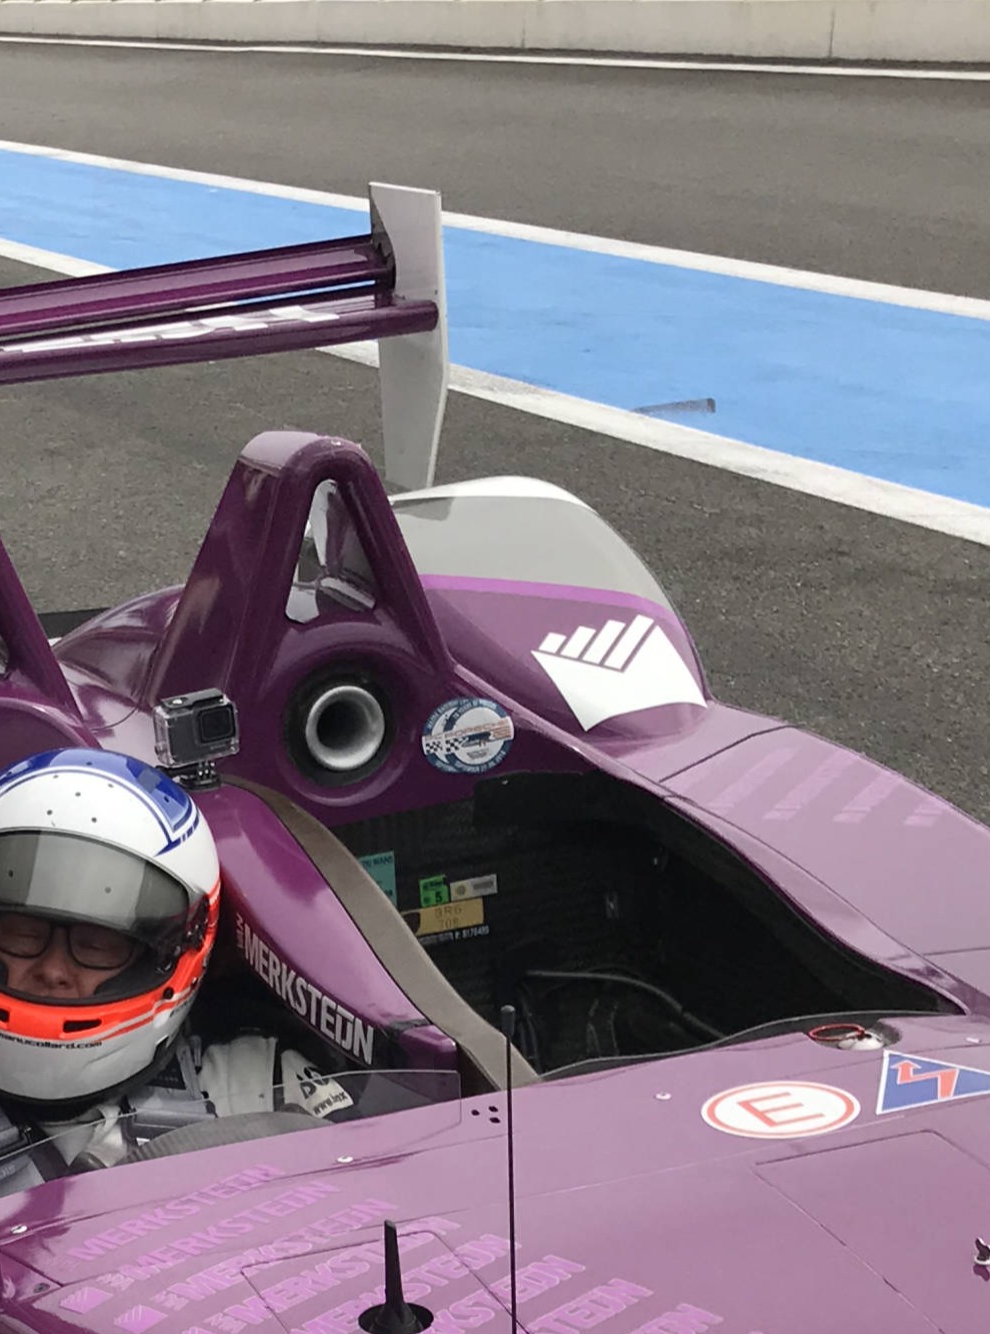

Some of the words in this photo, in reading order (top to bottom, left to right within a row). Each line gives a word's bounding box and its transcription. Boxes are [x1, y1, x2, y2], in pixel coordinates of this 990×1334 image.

[244, 923, 374, 1065] MERKSTEIJN
[737, 1091, 825, 1127] E
[167, 1197, 398, 1301] MERKSTEIJN
